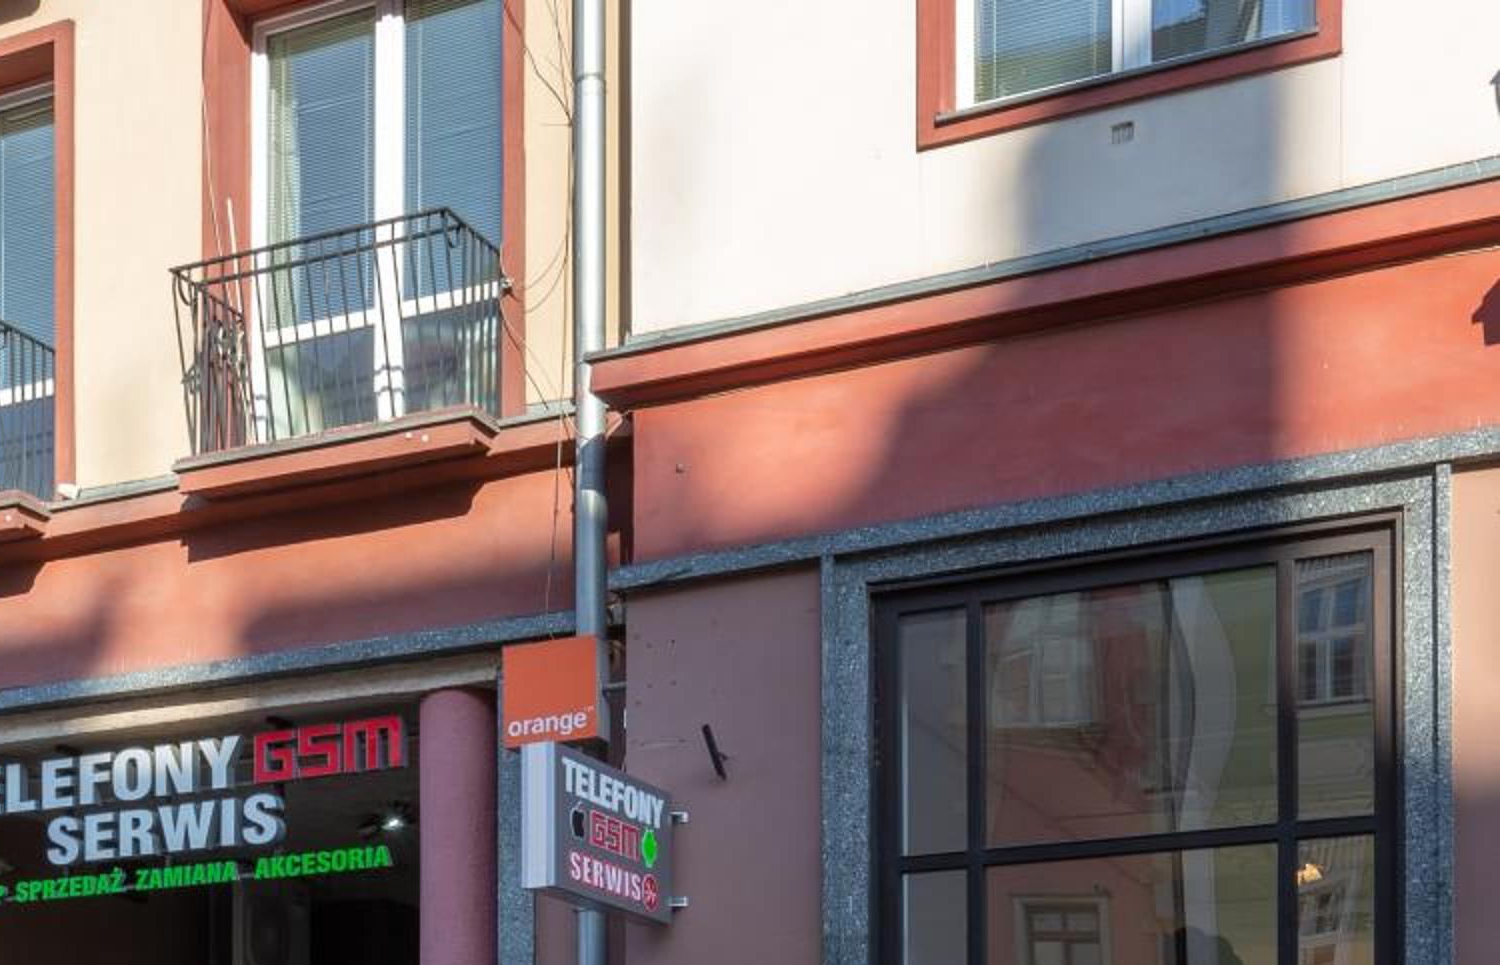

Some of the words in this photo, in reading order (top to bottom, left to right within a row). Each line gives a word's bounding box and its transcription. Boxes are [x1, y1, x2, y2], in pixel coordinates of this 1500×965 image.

[252, 715, 406, 784] GSM
[507, 710, 587, 737] orange
[561, 757, 665, 829] TELEFONY
[47, 793, 285, 866] SERWIS
[589, 809, 641, 862] GSM
[15, 867, 125, 903] SPRZEDAŻ
[135, 861, 238, 890] ZAMIANA
[254, 844, 391, 881] AKCESORIA
[569, 851, 642, 901] SERWIS
